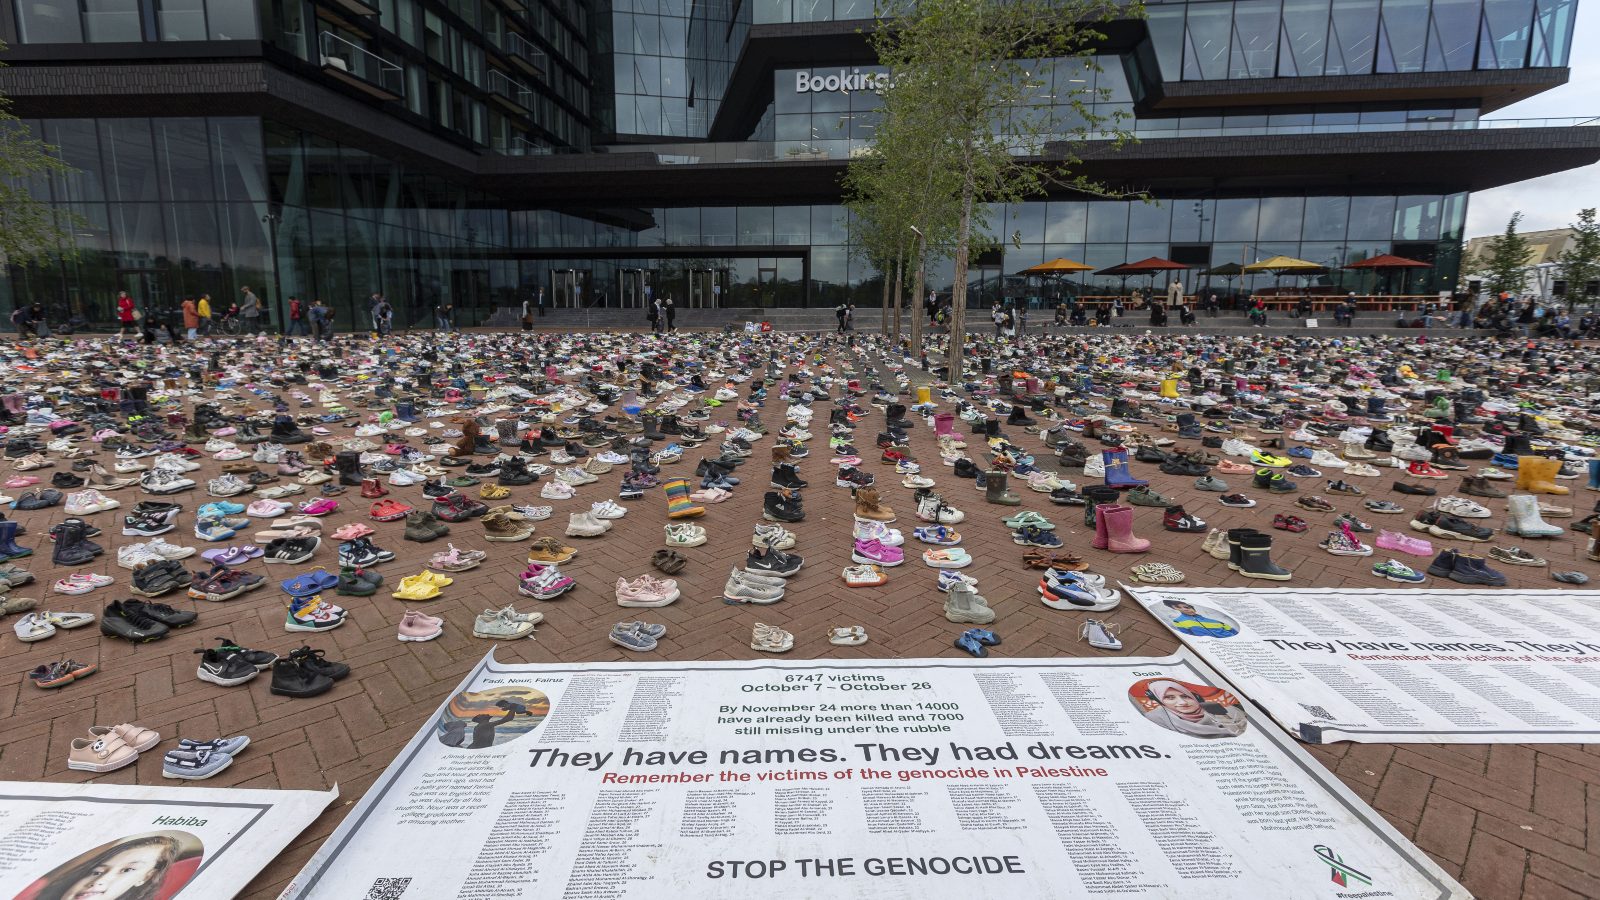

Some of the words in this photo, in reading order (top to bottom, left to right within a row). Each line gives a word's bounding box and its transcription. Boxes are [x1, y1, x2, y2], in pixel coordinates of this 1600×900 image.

[796, 68, 926, 94] Booking.
[1263, 639, 1338, 653] They
[1335, 639, 1409, 652] have
[1410, 641, 1515, 652] names.
[1504, 640, 1586, 655] They
[482, 677, 504, 685] Fadi,
[507, 677, 532, 685] Nour,
[785, 673, 824, 683] 6747
[828, 673, 886, 682] victims
[741, 683, 809, 693] October
[813, 683, 823, 692] 7
[840, 682, 908, 692] October
[911, 681, 932, 690] 26
[719, 704, 738, 714] By
[742, 703, 816, 713] November
[819, 703, 837, 712] 24
[840, 704, 877, 712] more
[880, 703, 912, 711] than
[916, 702, 960, 711] 14000
[717, 716, 752, 724] have
[756, 714, 811, 724] already
[815, 714, 852, 723] been
[855, 713, 894, 722] killed
[897, 713, 926, 722] and
[929, 713, 965, 721] 7000
[735, 726, 761, 735] still
[765, 725, 823, 735] missing
[827, 725, 871, 734] under
[875, 725, 899, 733] the
[903, 724, 951, 733] rubble
[528, 747, 613, 771] They
[622, 747, 709, 766] have
[719, 747, 847, 765] names.
[854, 743, 940, 766] They
[949, 741, 1018, 761] had
[1027, 741, 1172, 761] dreams.
[602, 771, 715, 785] Remember
[719, 770, 751, 782] the
[757, 768, 828, 781] victims
[833, 768, 853, 780] of
[859, 768, 893, 780] the
[897, 766, 989, 782] genocide
[993, 767, 1012, 778] in
[1016, 766, 1109, 778] Palestine
[151, 815, 209, 827] Habiba
[706, 860, 787, 879] STOP
[794, 857, 856, 878] THE
[863, 855, 1026, 876] GENOCIDE
